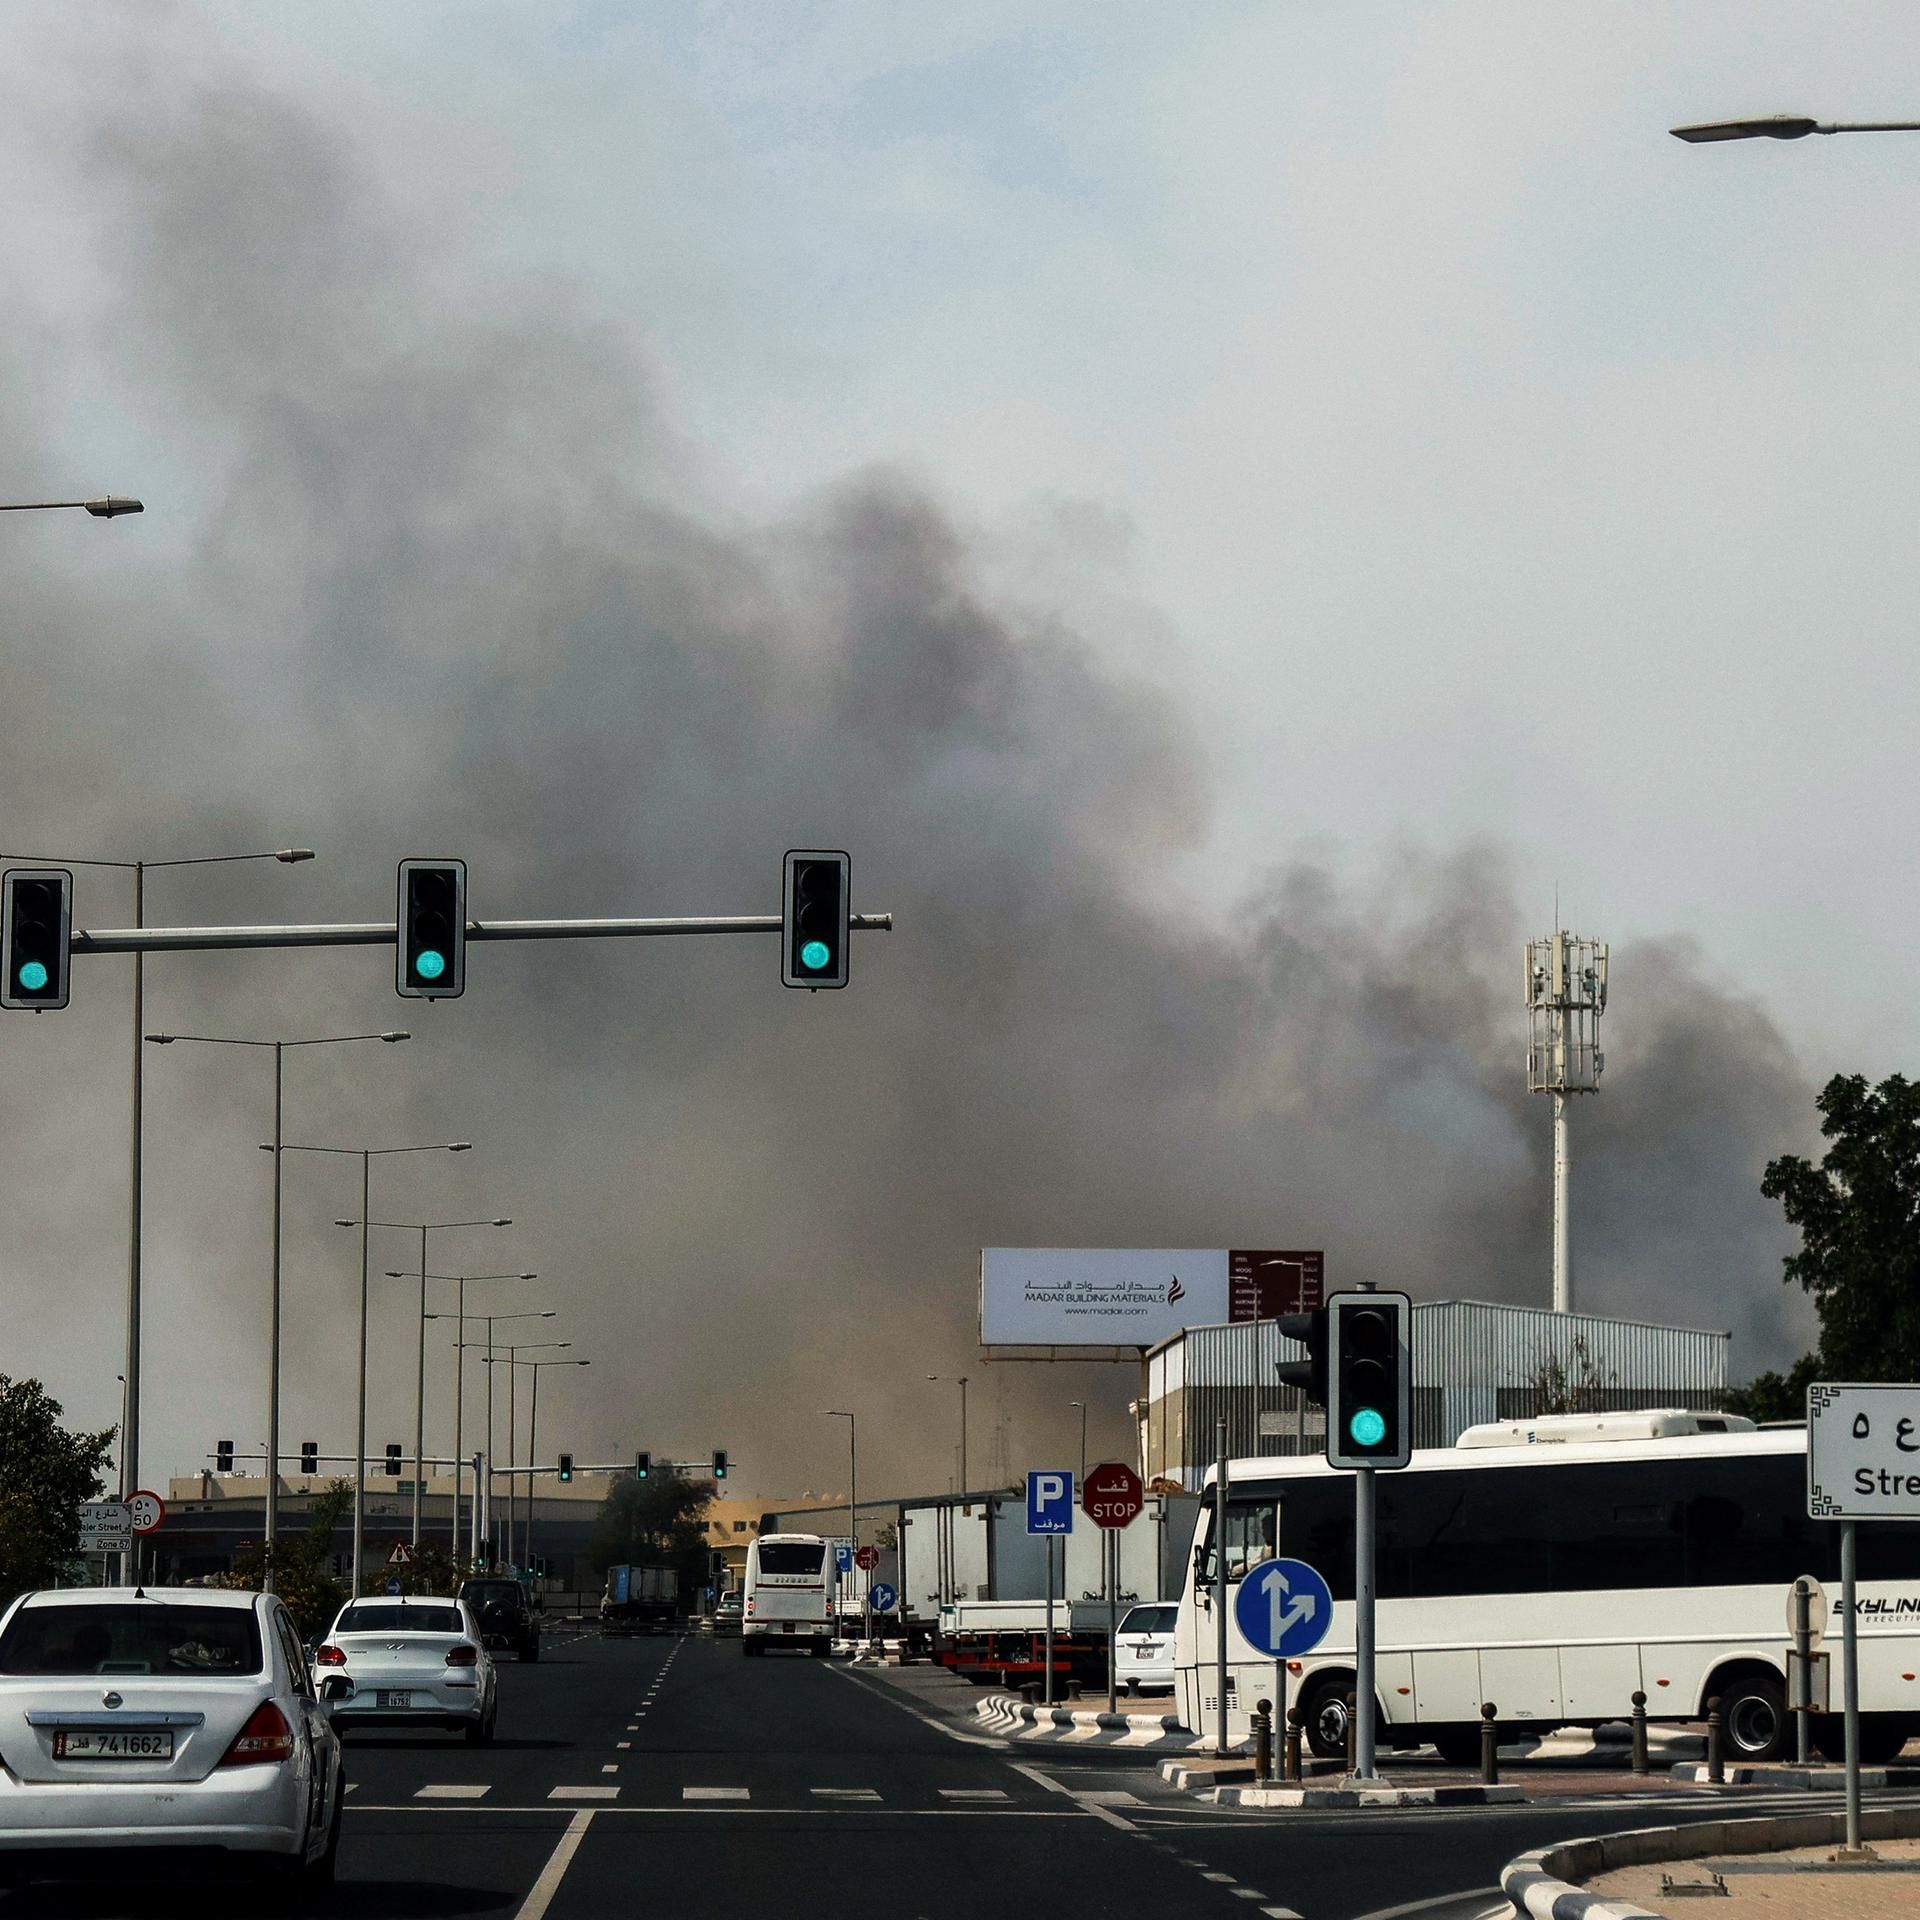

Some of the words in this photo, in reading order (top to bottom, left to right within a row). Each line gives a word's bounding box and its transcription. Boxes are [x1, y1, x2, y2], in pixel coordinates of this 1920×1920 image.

[1025, 1293, 1064, 1302] MADAR
[1066, 1293, 1109, 1303] BUILDING
[1110, 1293, 1166, 1304] MATERIALS
[1065, 1307, 1149, 1316] www.madar.com
[1096, 1475, 1129, 1493] قف
[1854, 1467, 1920, 1496] Stre
[1036, 1475, 1064, 1513] P
[1093, 1502, 1137, 1518] STOP
[98, 1523, 122, 1531] Street
[133, 1514, 152, 1527] 50
[1034, 1518, 1066, 1531] موقف
[1832, 1598, 1920, 1615] SKYLIN
[1866, 1614, 1920, 1624] EXECUTIV
[97, 1736, 162, 1754] 741662
